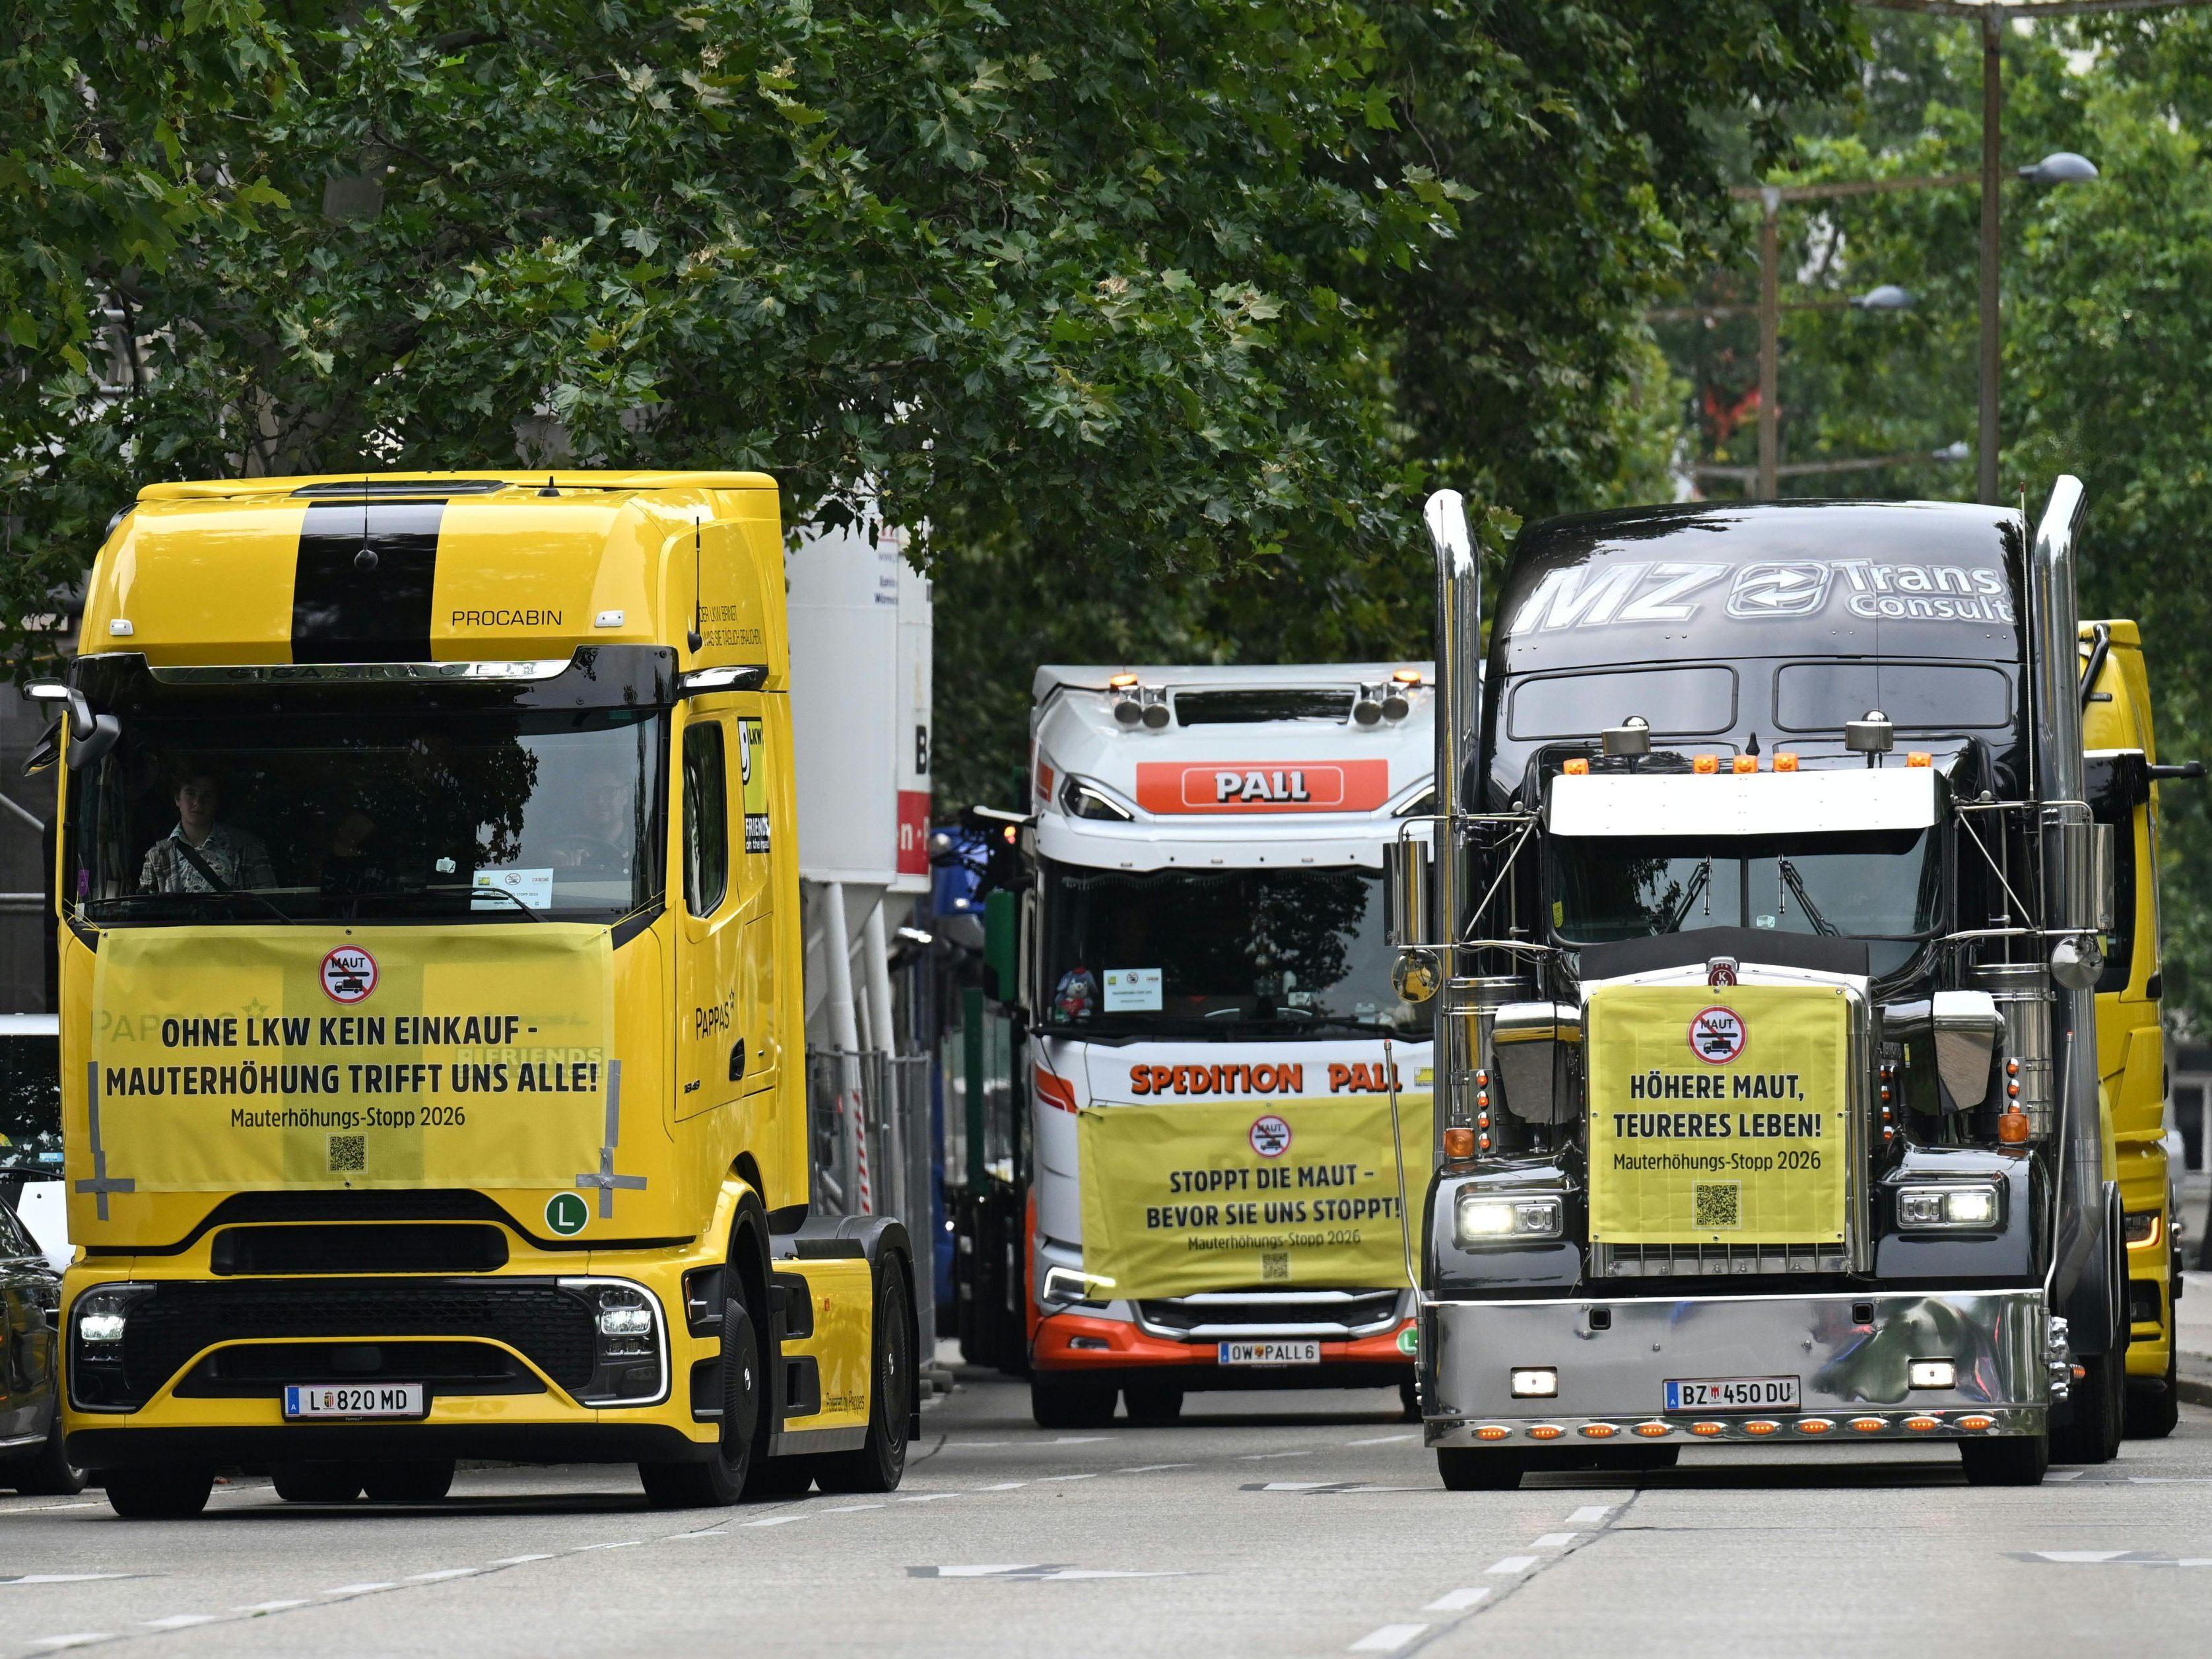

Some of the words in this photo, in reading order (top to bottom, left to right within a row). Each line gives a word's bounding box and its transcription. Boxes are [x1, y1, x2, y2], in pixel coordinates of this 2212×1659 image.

[1831, 560, 2003, 594] Trans
[1507, 562, 1727, 638] MZ
[1850, 593, 2013, 622] Consult
[452, 610, 562, 626] PROCABIN
[226, 664, 491, 679] GIGASPACE
[749, 728, 762, 745] LKW
[1215, 770, 1310, 802] PALL
[745, 817, 770, 836] FRIENDS
[331, 957, 365, 968] MAUT
[162, 1017, 238, 1048] OHNE
[247, 1017, 311, 1046] LKW
[320, 1016, 385, 1046] KEIN
[395, 1015, 519, 1045] EINKAUF
[695, 1001, 730, 1041] PAPPAS
[1700, 1019, 1734, 1030] MAUT
[106, 1060, 339, 1096] MAUTERHÖHUNG
[349, 1064, 442, 1094] TRIFFT
[452, 1064, 508, 1093] UNS
[518, 1063, 597, 1092] ALLE!
[1129, 1063, 1303, 1095] SPEDITION
[1327, 1062, 1403, 1093] PALL
[1630, 1070, 1726, 1099] HÖHERE
[1733, 1075, 1804, 1102] MAUT,
[231, 1106, 415, 1130] Mauterhöhungs-Stopp
[420, 1106, 465, 1126] 2026
[1257, 1124, 1282, 1132] MAUT
[1613, 1113, 1731, 1137] TEURERES
[1739, 1113, 1821, 1137] LEBEN!
[1613, 1153, 1773, 1172] Mauterhöhungs-Stopp
[1777, 1151, 1821, 1170] 2026
[1170, 1168, 1249, 1193] STOPPT
[1256, 1167, 1290, 1190] DIE
[1298, 1164, 1357, 1188] MAUT
[558, 1202, 575, 1227] L
[1147, 1204, 1219, 1229] BEVOR
[1226, 1202, 1257, 1225] SIE
[1264, 1200, 1306, 1224] UNS
[1313, 1196, 1401, 1221] STOPPT!
[1188, 1231, 1324, 1251] Mauterhöhungs-Stopp
[1327, 1229, 1361, 1245] 2026
[1232, 1345, 1254, 1360] OW
[1265, 1345, 1302, 1360] PALL
[1305, 1344, 1314, 1359] 6
[1404, 1332, 1417, 1351] L
[310, 1390, 320, 1411] L
[337, 1390, 375, 1411] 820
[381, 1389, 407, 1410] MD
[1683, 1385, 1707, 1405] BZ
[1724, 1384, 1760, 1404] 450
[1766, 1382, 1791, 1402] DU
